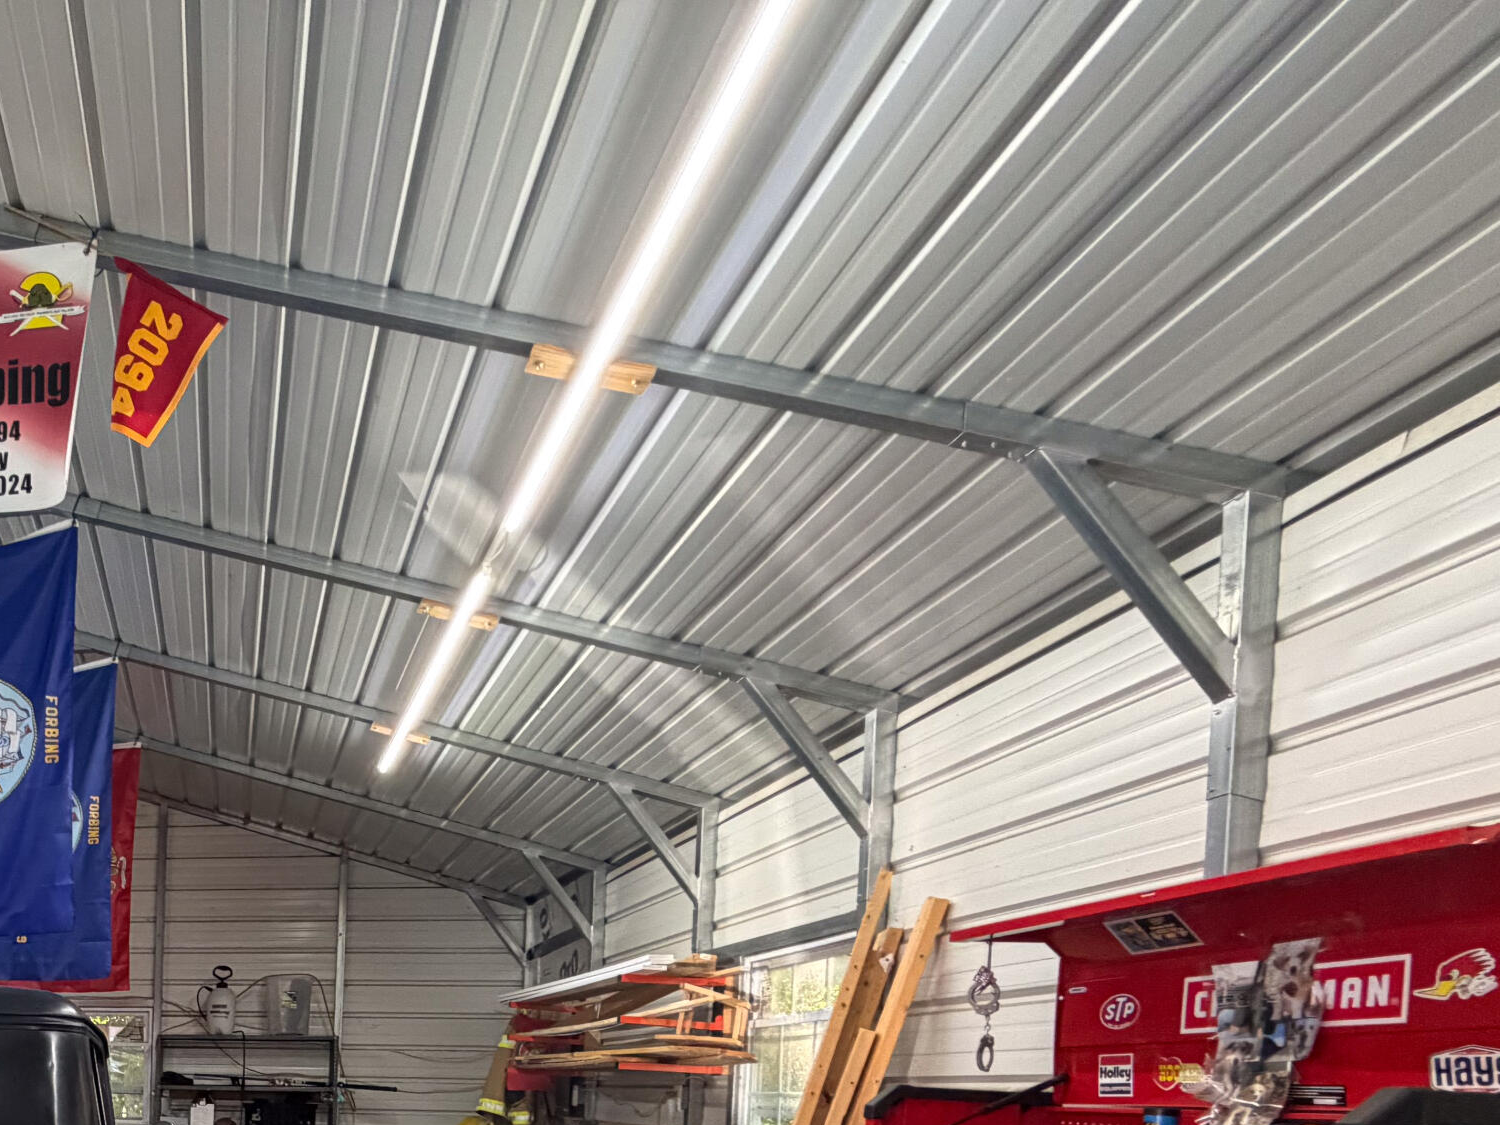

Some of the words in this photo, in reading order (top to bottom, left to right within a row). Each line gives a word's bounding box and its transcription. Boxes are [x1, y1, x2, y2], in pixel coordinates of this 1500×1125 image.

[112, 300, 183, 418] 2094
[44, 695, 60, 764] FORBING
[88, 795, 101, 845] FORBING
[1105, 996, 1135, 1022] STP
[1100, 1066, 1131, 1081] Holley
[1434, 1056, 1500, 1086] Hay
